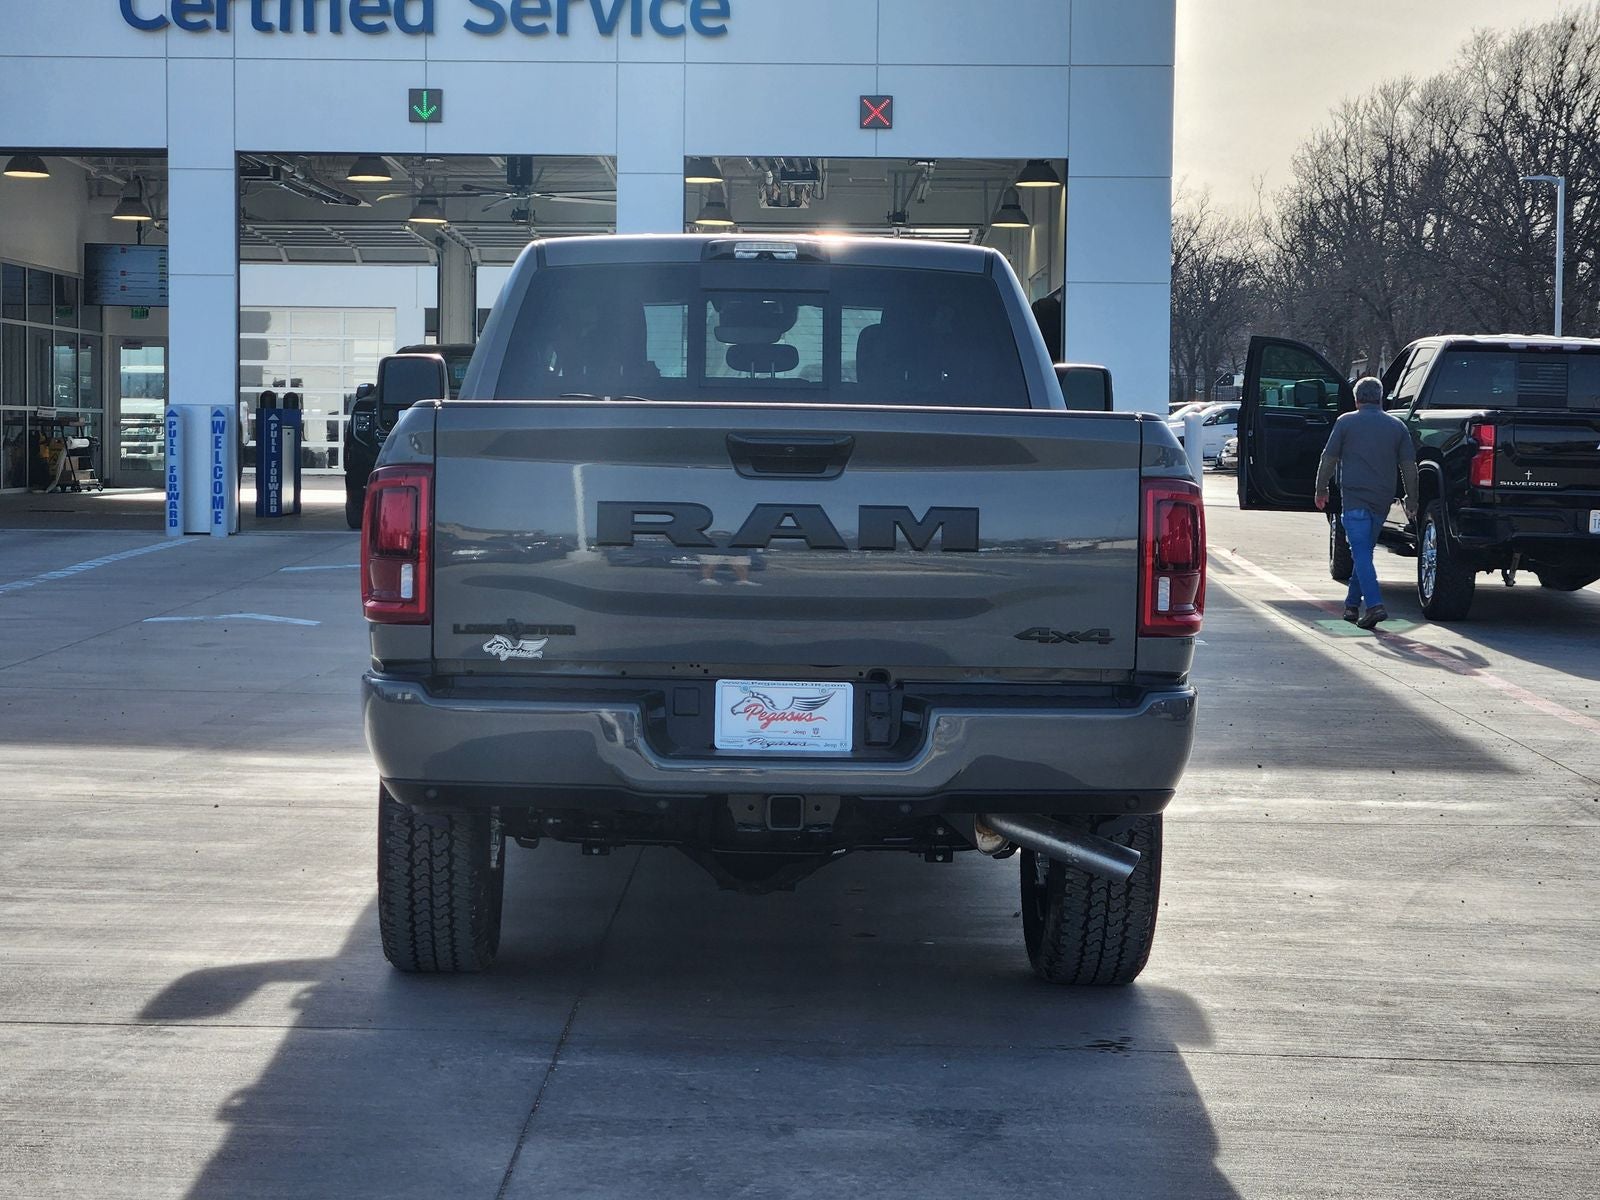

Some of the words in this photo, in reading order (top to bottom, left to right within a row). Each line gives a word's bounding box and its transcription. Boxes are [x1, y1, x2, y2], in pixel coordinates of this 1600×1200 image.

[463, 0, 731, 37] Service
[168, 420, 177, 456] PULL
[270, 422, 278, 454] PULL
[211, 420, 226, 525] WELCOME
[268, 460, 279, 513] FORWARD
[1499, 480, 1558, 488] SILVERADO
[167, 465, 180, 528] FORWARD
[596, 500, 981, 552] RAM
[743, 703, 828, 730] Pegasus
